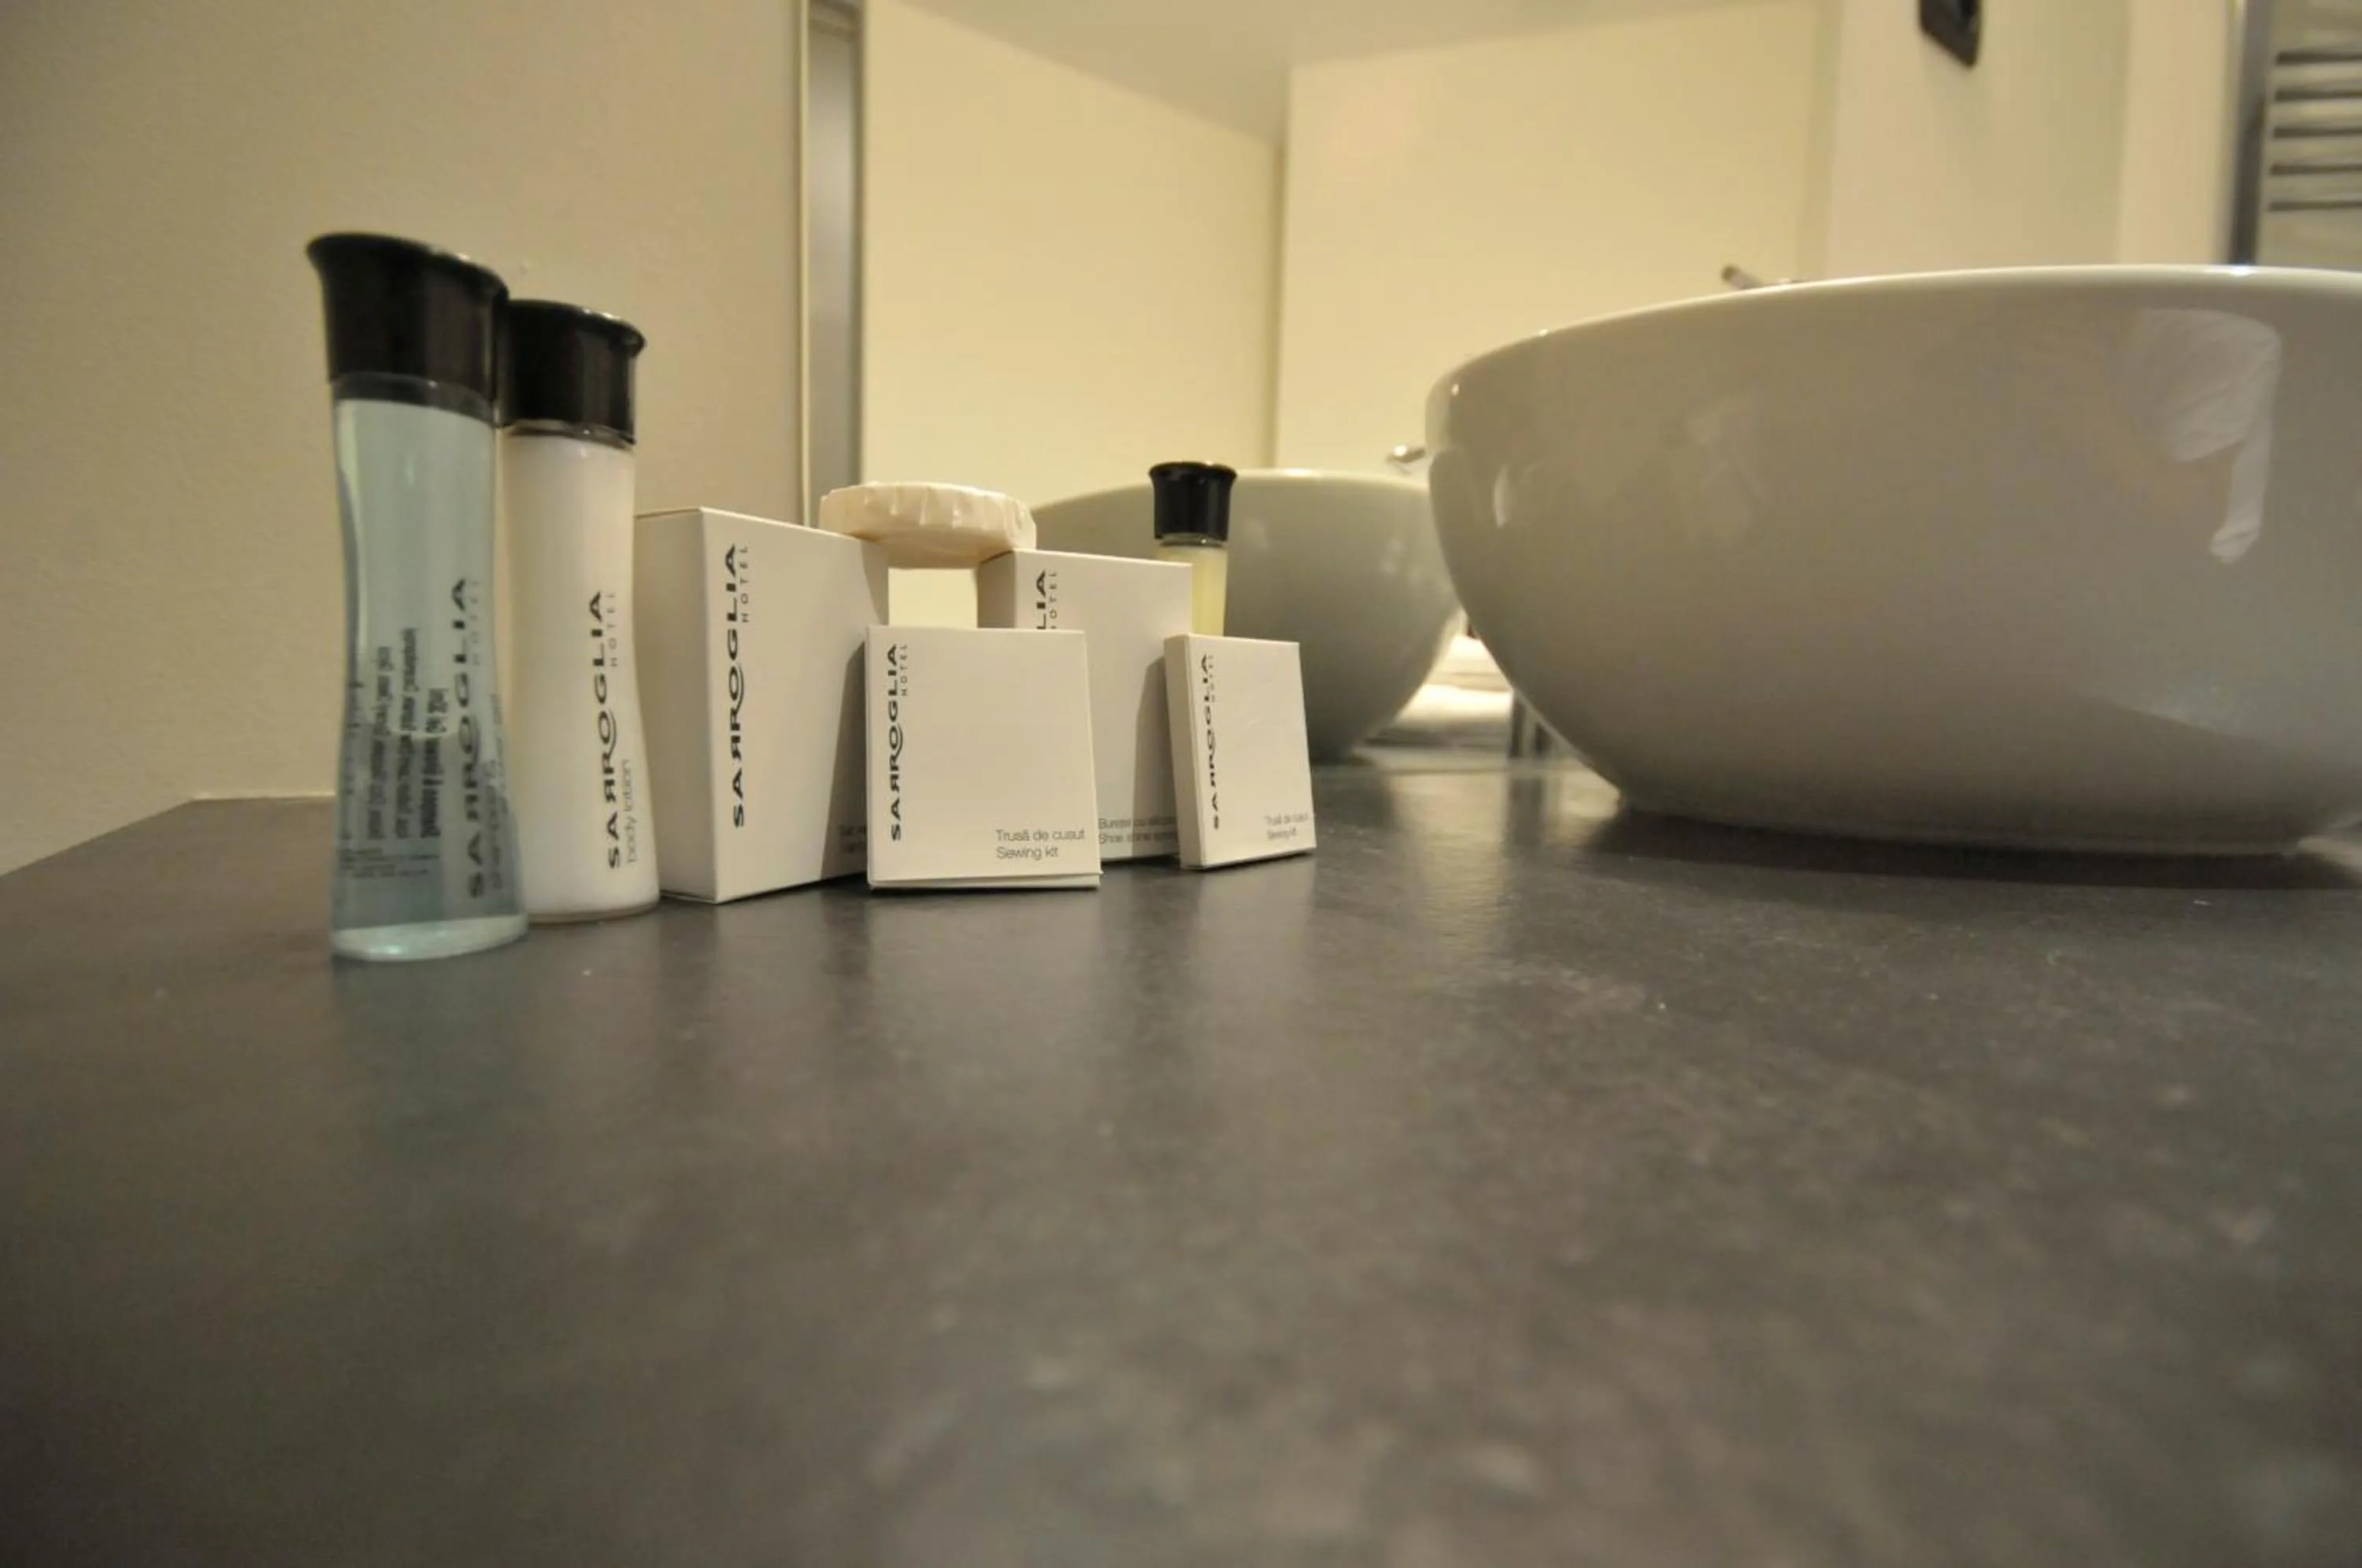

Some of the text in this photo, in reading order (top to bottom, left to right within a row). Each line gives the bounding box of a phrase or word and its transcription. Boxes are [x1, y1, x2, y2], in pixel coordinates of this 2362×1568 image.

[605, 594, 618, 667] HOTEL
[739, 545, 750, 623] HOTEL
[451, 578, 483, 898] SARROGLIA
[589, 591, 620, 868] SARROGLIA
[724, 543, 744, 828] SARROGLIA
[887, 644, 903, 842] SARROGLIA
[624, 815, 639, 863] body
[995, 845, 1059, 861] Sewing kit
